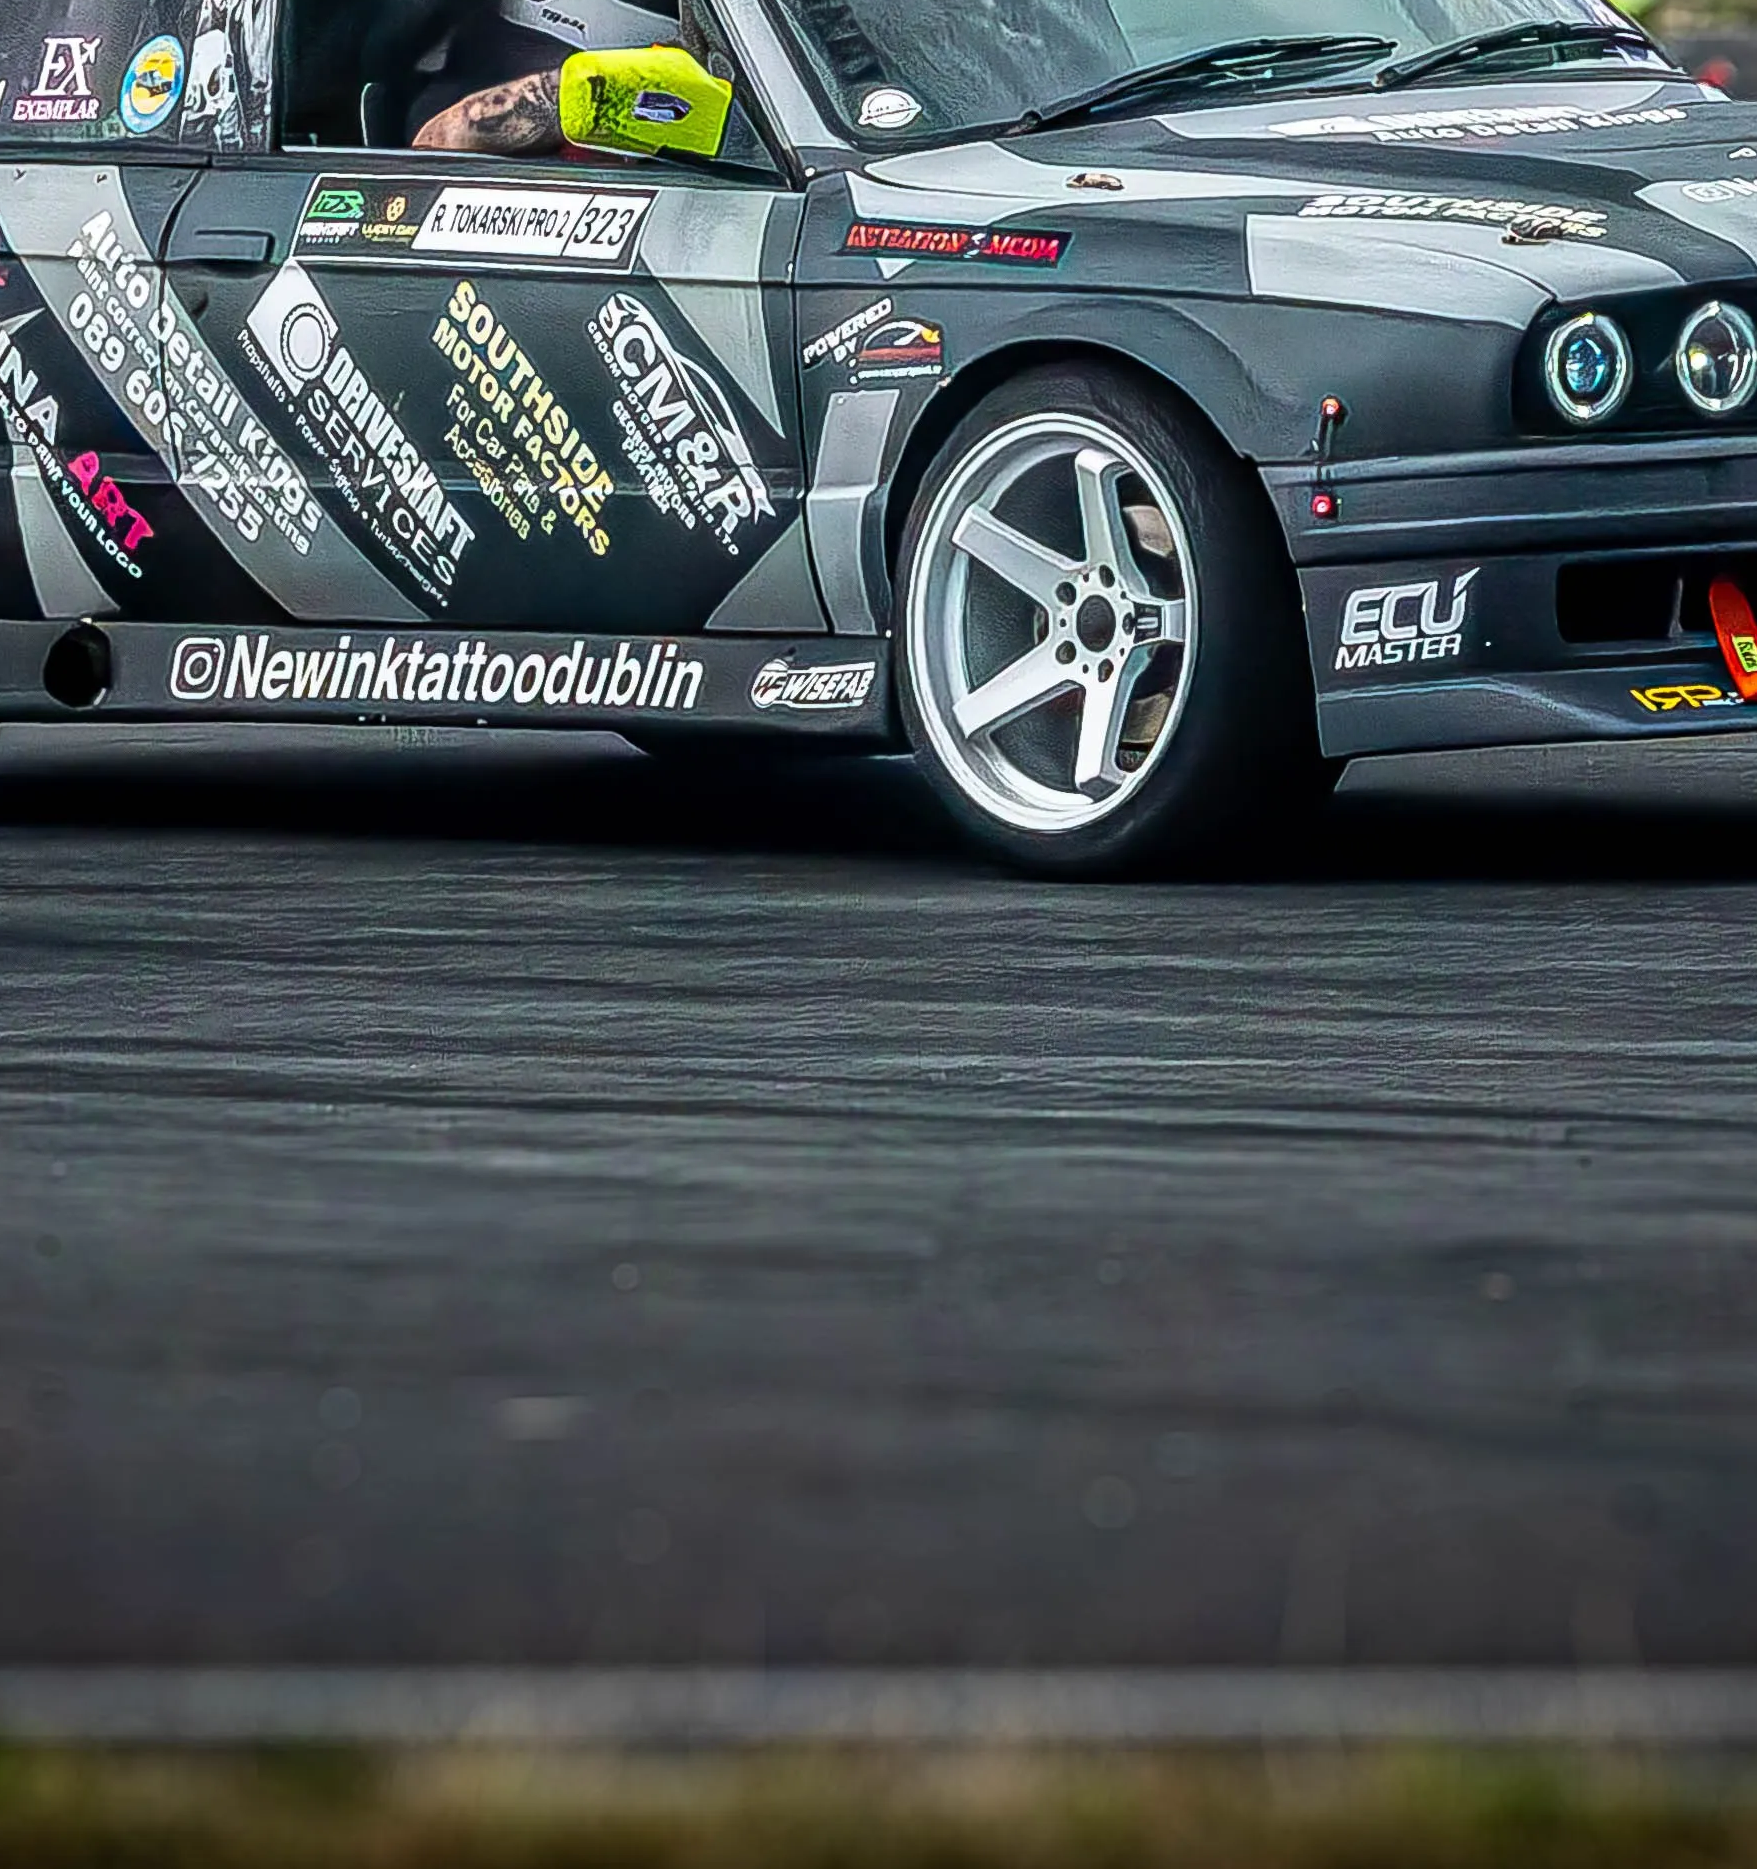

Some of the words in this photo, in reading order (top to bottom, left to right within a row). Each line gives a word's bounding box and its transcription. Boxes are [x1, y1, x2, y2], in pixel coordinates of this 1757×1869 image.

[12, 96, 101, 123] EXEMPLAR
[1372, 127, 1465, 142] Auto
[451, 203, 525, 236] TOKARSKI
[522, 209, 556, 238] PRO
[556, 211, 571, 240] 2
[573, 208, 636, 247] 323
[68, 291, 125, 372] 089
[803, 297, 893, 364] POWERED
[81, 210, 151, 309] Auto
[238, 416, 323, 533] Kings
[448, 280, 614, 514] SOUTHSIDE
[322, 346, 477, 562] DRIVESHAFT
[431, 317, 515, 424] MOTOR
[512, 414, 610, 557] FACTORS
[445, 383, 477, 427] For
[474, 417, 508, 461] Car
[539, 509, 557, 536] &
[68, 450, 154, 550] ART
[306, 388, 457, 586] SERVICES
[95, 529, 143, 579] LOGO
[1340, 573, 1476, 646] ECU
[222, 634, 705, 709] Newinktattoodublin
[781, 669, 875, 701] WISEFAB
[1334, 633, 1462, 670] MASTER
